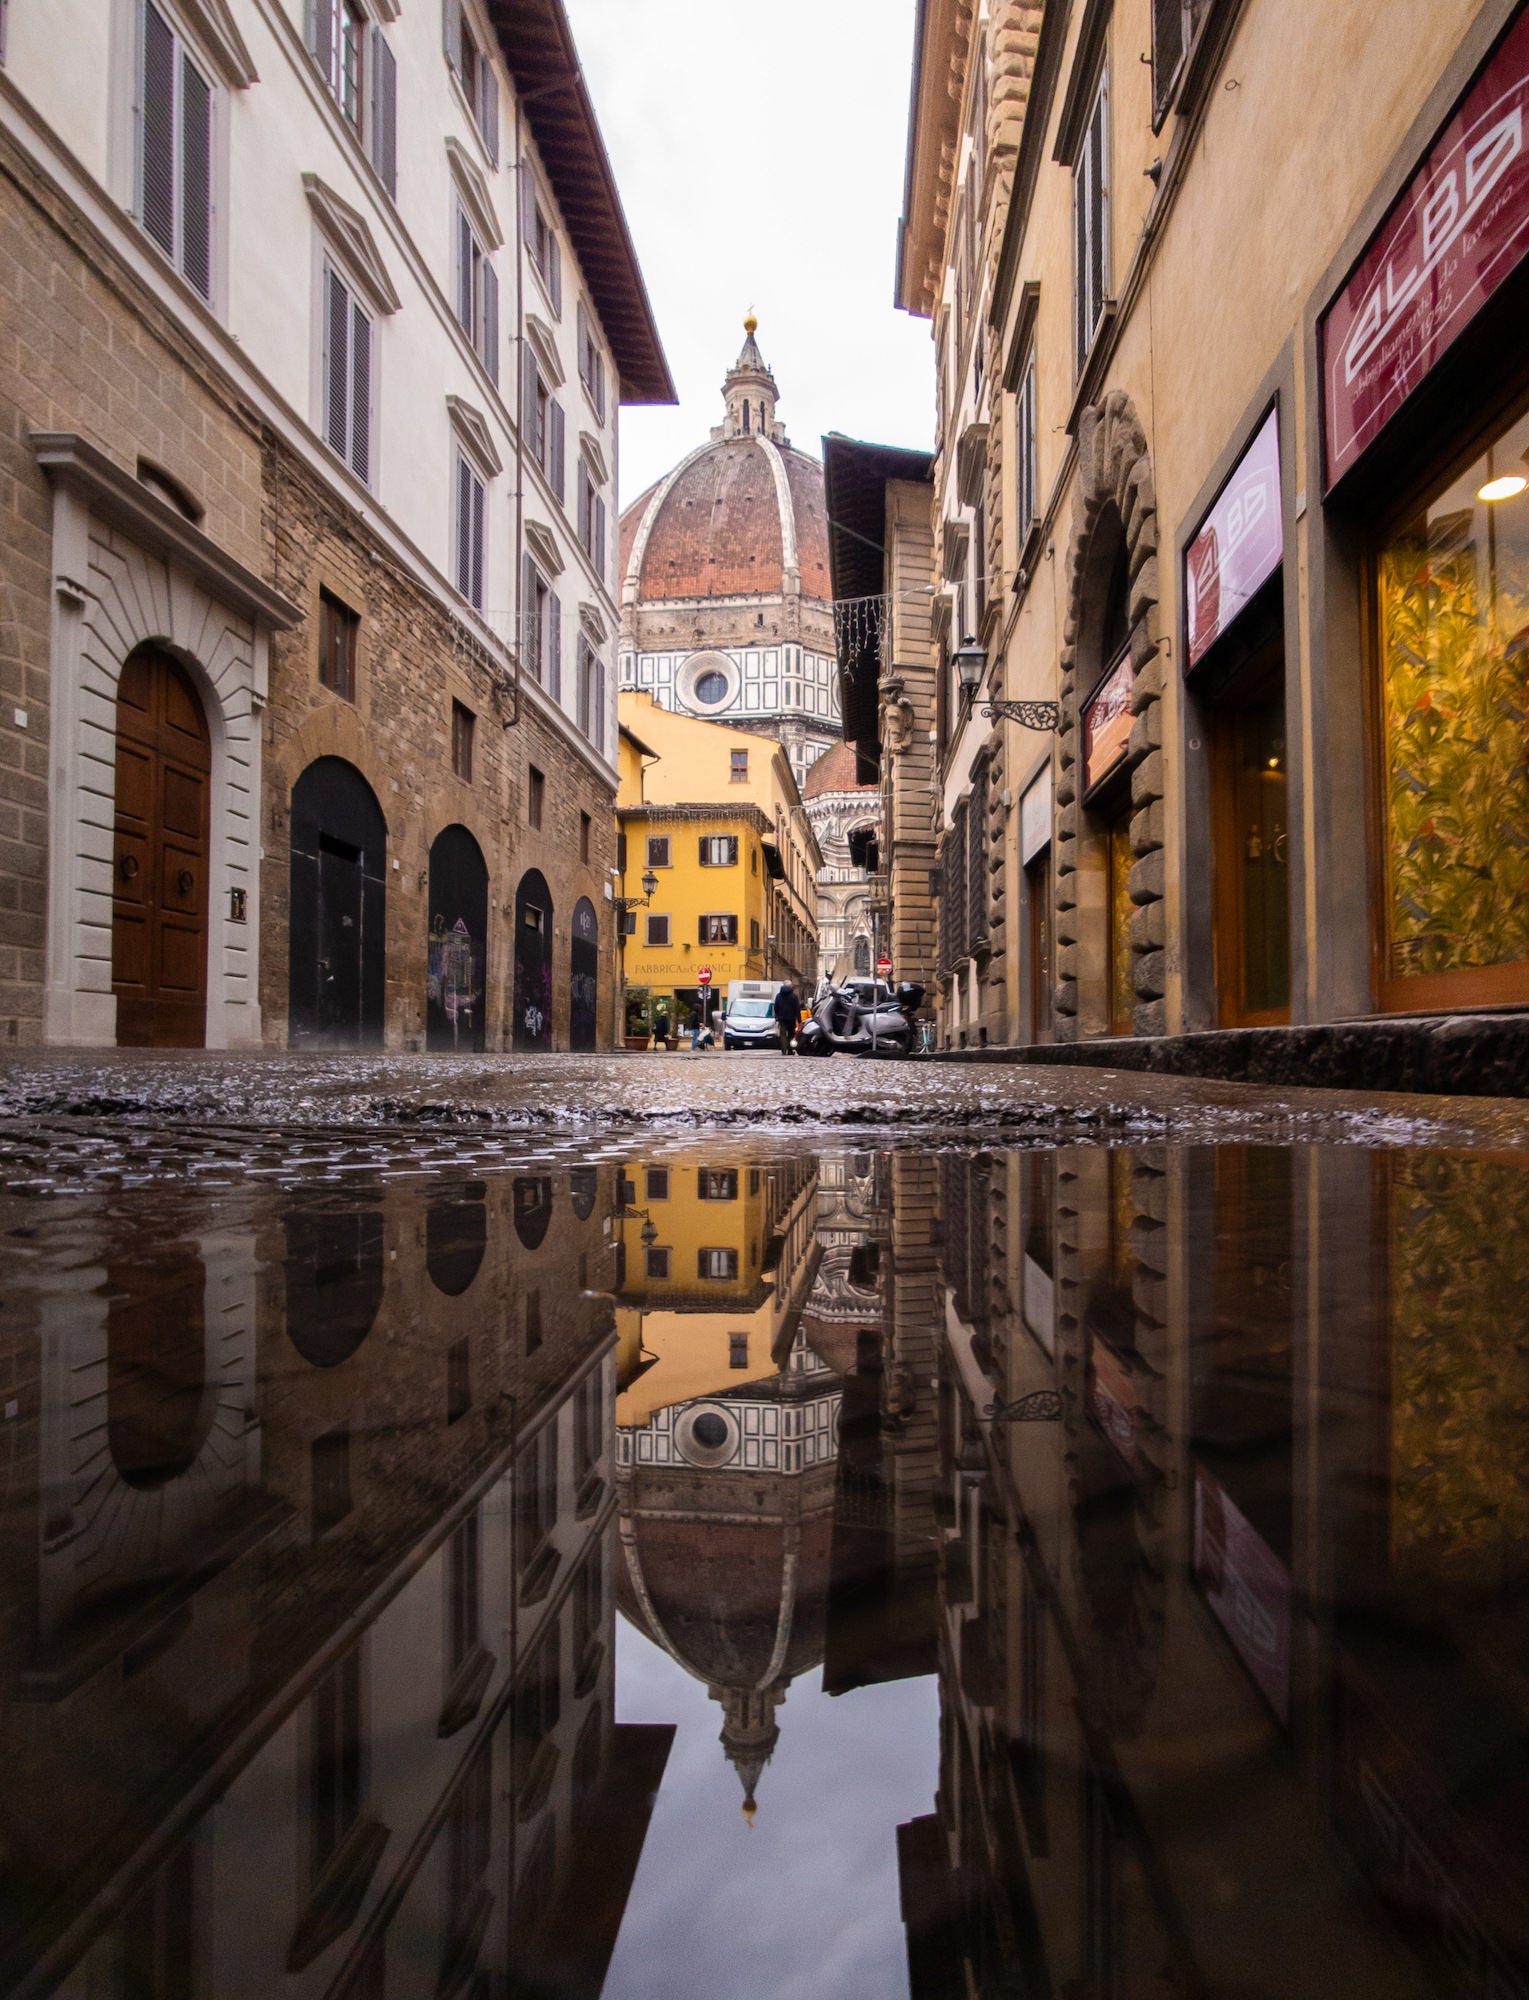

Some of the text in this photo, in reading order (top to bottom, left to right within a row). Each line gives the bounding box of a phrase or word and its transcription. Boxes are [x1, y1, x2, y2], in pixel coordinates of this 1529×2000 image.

[1345, 105, 1522, 387] ALBA
[1354, 185, 1512, 399] abbigliamento da lavoro
[1394, 288, 1452, 372] dal 1956
[635, 964, 681, 973] FABBRICA
